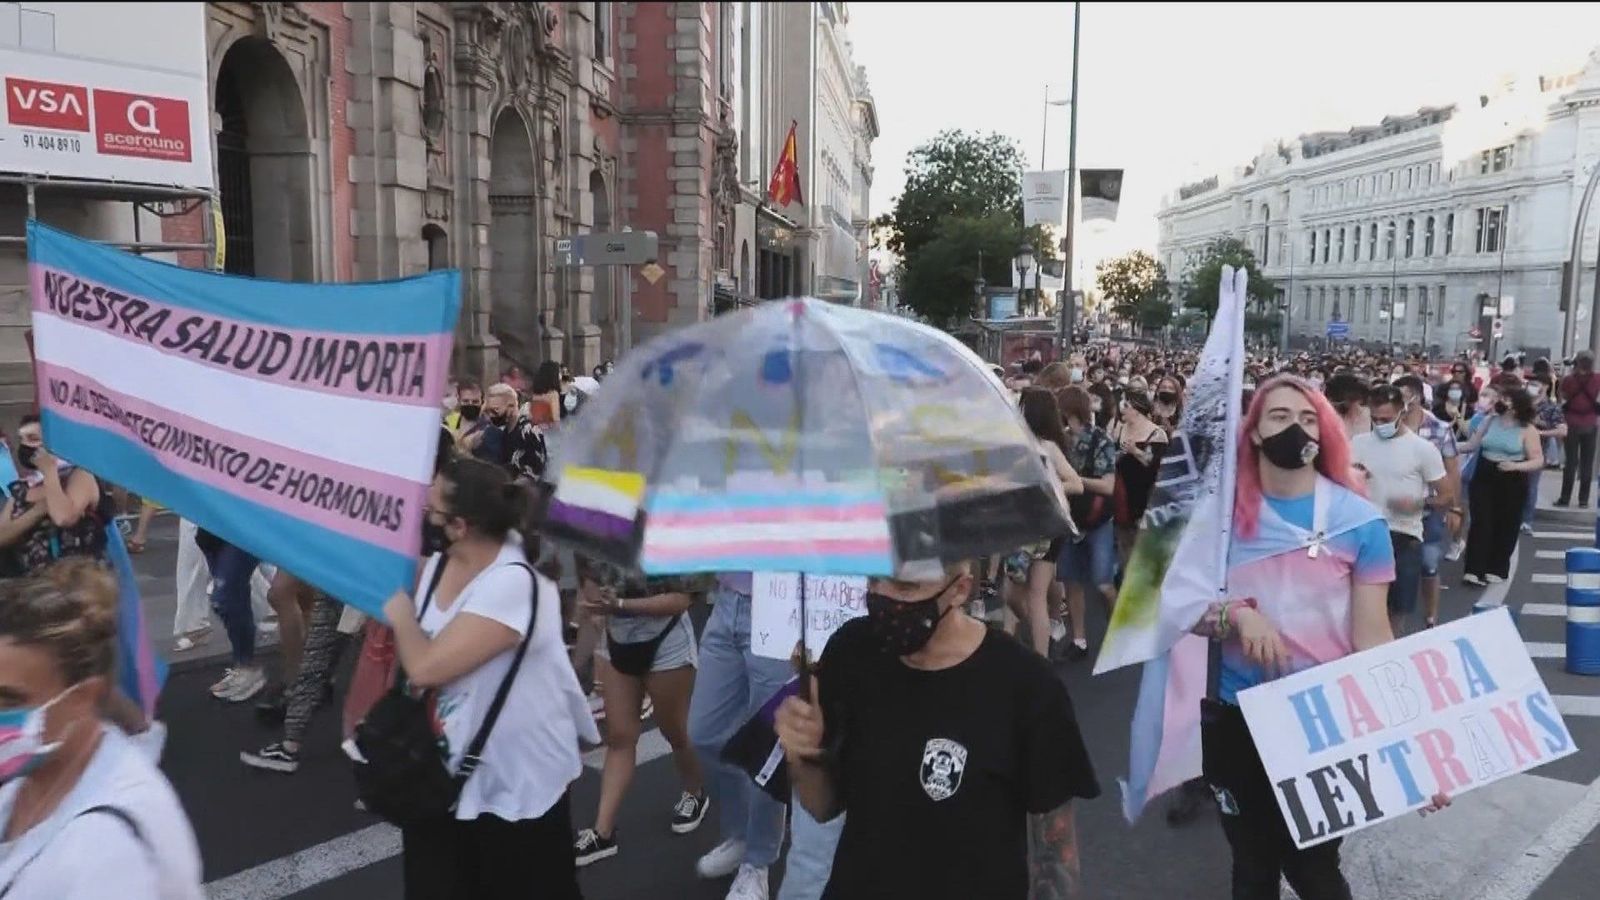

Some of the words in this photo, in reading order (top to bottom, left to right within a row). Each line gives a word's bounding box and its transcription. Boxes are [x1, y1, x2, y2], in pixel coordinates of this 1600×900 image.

[13, 86, 83, 116] VSA
[23, 134, 34, 148] 91
[38, 136, 55, 150] 404
[57, 138, 69, 151] 89
[71, 139, 81, 153] 10
[104, 132, 185, 150] acerouno
[44, 270, 171, 344] NUESTRA
[161, 316, 292, 375] SALUD
[290, 336, 427, 397] IMPORTA
[49, 377, 69, 405] NO
[243, 457, 287, 491] DE
[278, 466, 405, 531] HORMONAS
[769, 579, 787, 601] NO
[1288, 637, 1499, 754] HABRA
[1277, 753, 1385, 843] LEY
[1377, 691, 1568, 807] TRANS
